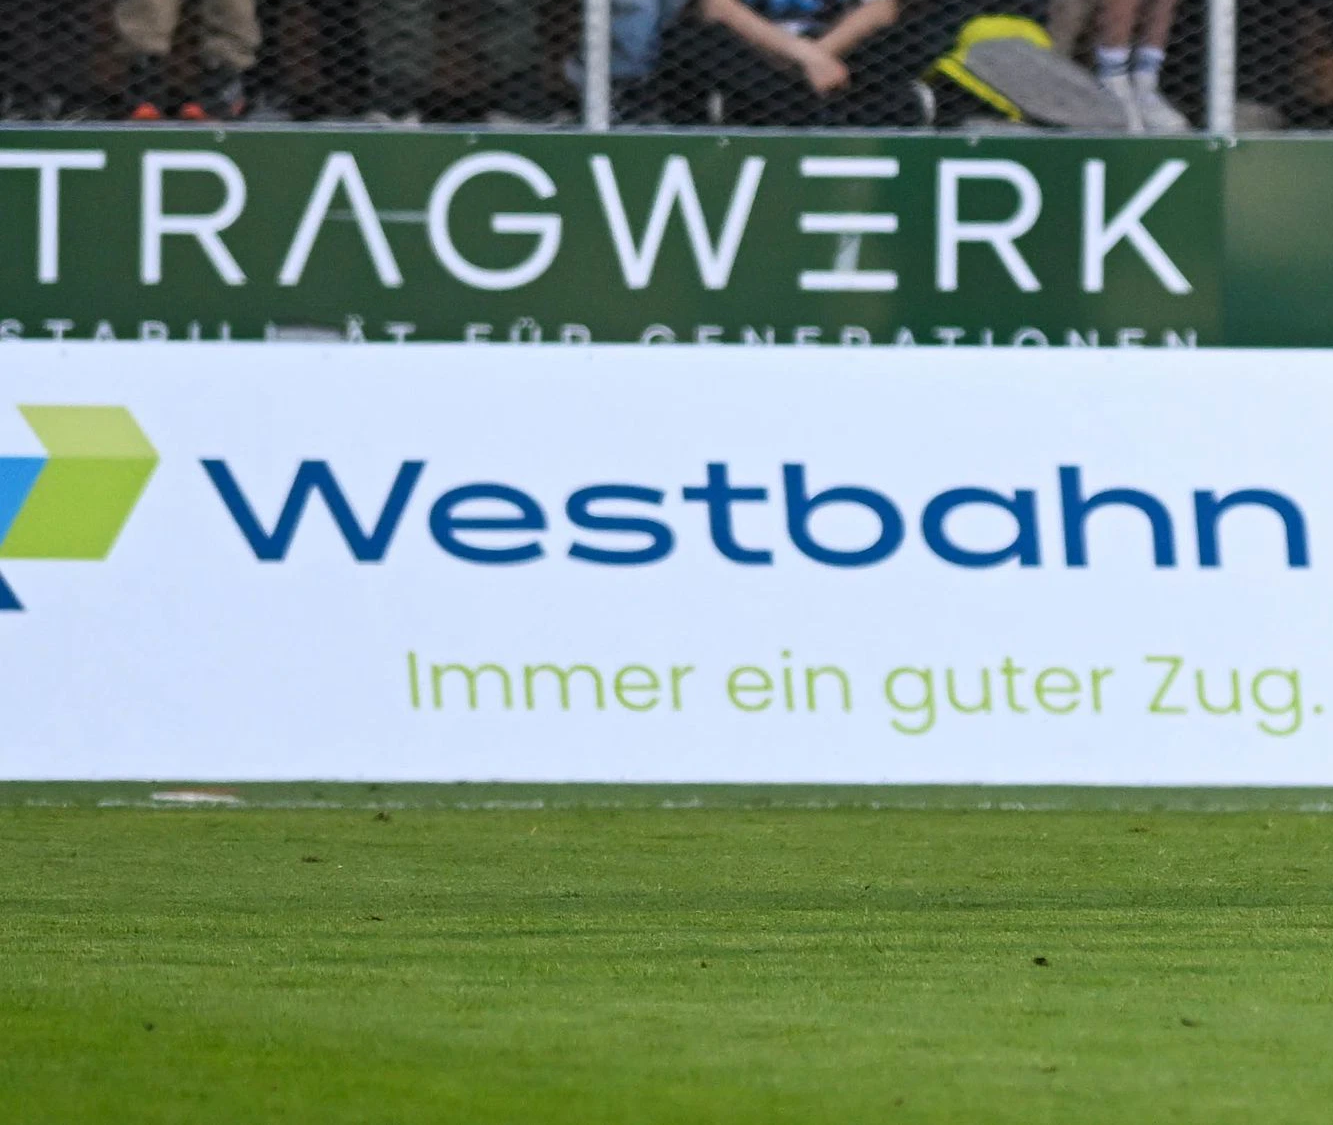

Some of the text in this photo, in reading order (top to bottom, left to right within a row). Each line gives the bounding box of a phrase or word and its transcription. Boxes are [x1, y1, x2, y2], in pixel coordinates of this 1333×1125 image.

[0, 150, 1192, 293] TRAGWERK
[200, 458, 1312, 569] Westbahn
[406, 650, 1325, 737] Immer ein guter Zug.
